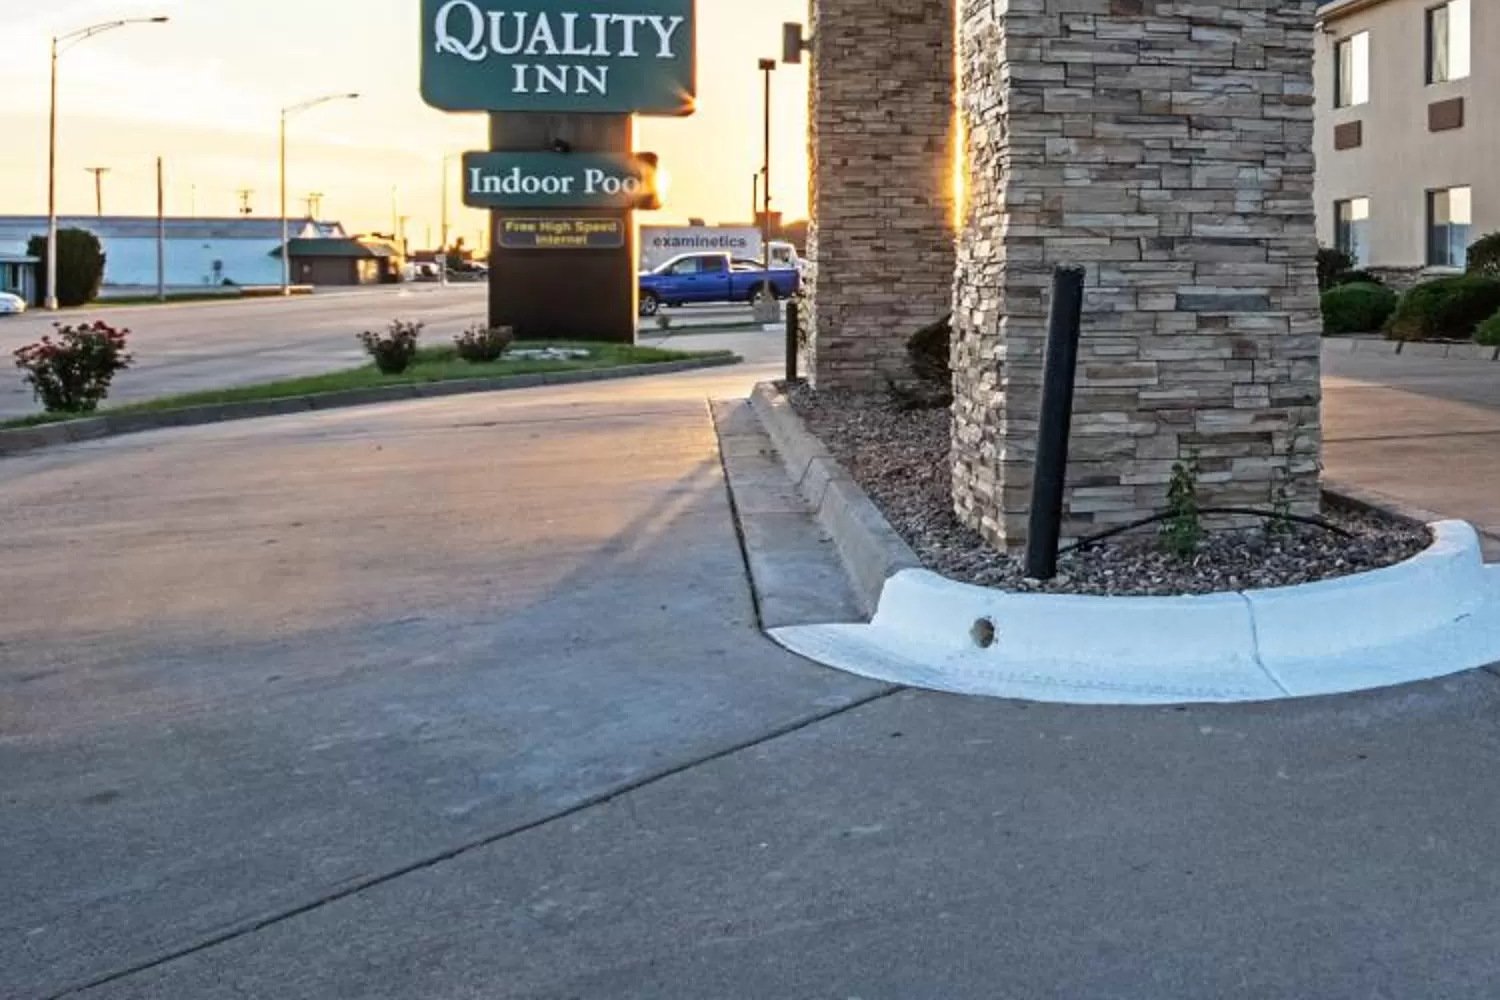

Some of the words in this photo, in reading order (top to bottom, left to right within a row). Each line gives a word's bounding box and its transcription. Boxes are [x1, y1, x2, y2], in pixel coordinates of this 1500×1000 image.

[435, 0, 684, 62] QUALITY
[511, 64, 609, 95] INN
[470, 166, 575, 194] Indoor
[584, 168, 646, 195] Poo
[505, 221, 536, 232] Free
[539, 221, 571, 234] High
[653, 234, 747, 248] examinetics
